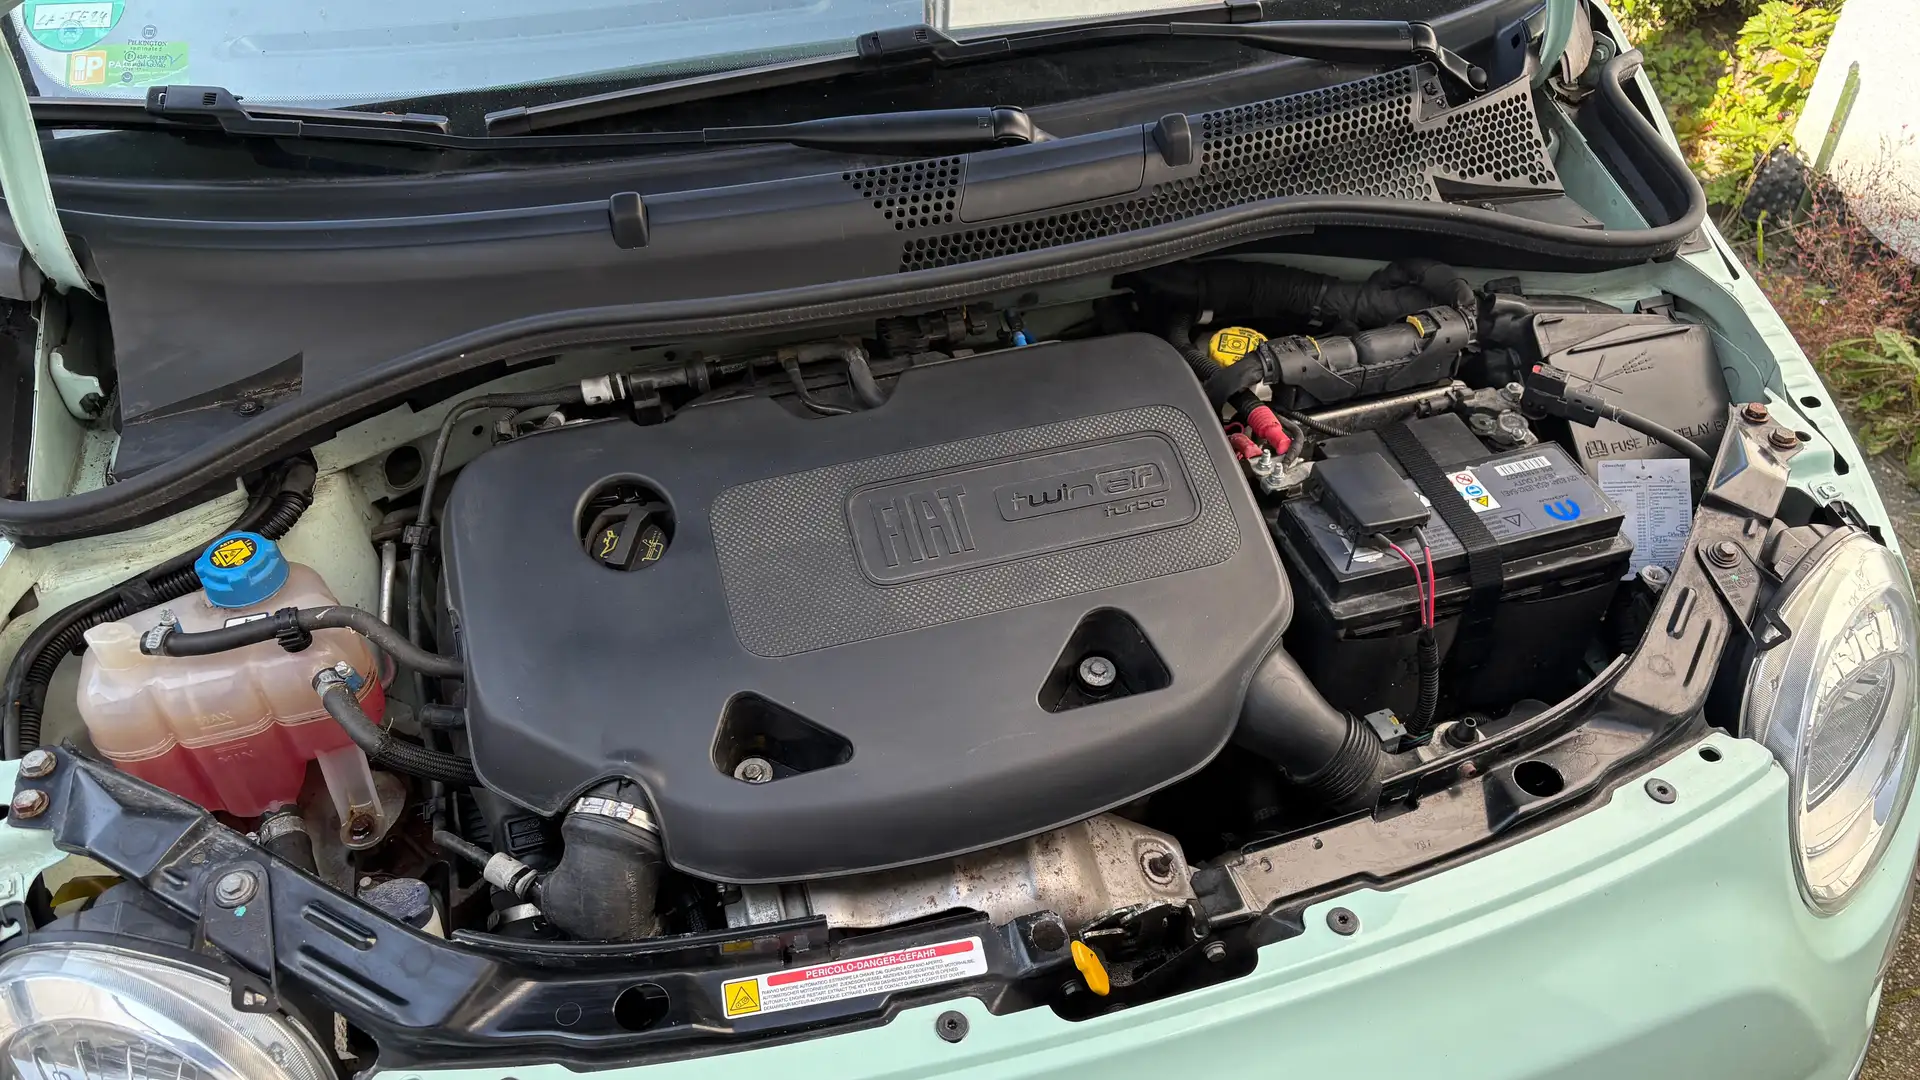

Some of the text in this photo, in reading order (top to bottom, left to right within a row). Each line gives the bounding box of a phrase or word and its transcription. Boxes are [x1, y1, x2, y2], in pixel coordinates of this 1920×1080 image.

[127, 39, 168, 47] PILKINGTON
[1610, 438, 1643, 454] FUSE
[1674, 422, 1711, 438] RELAY
[1513, 479, 1533, 487] DUTY
[1104, 496, 1167, 518] turbo
[869, 484, 976, 568] FIAT
[805, 948, 937, 979] PERICOLO-DANGER-GEFAHR
[779, 984, 799, 992] MOTORE
